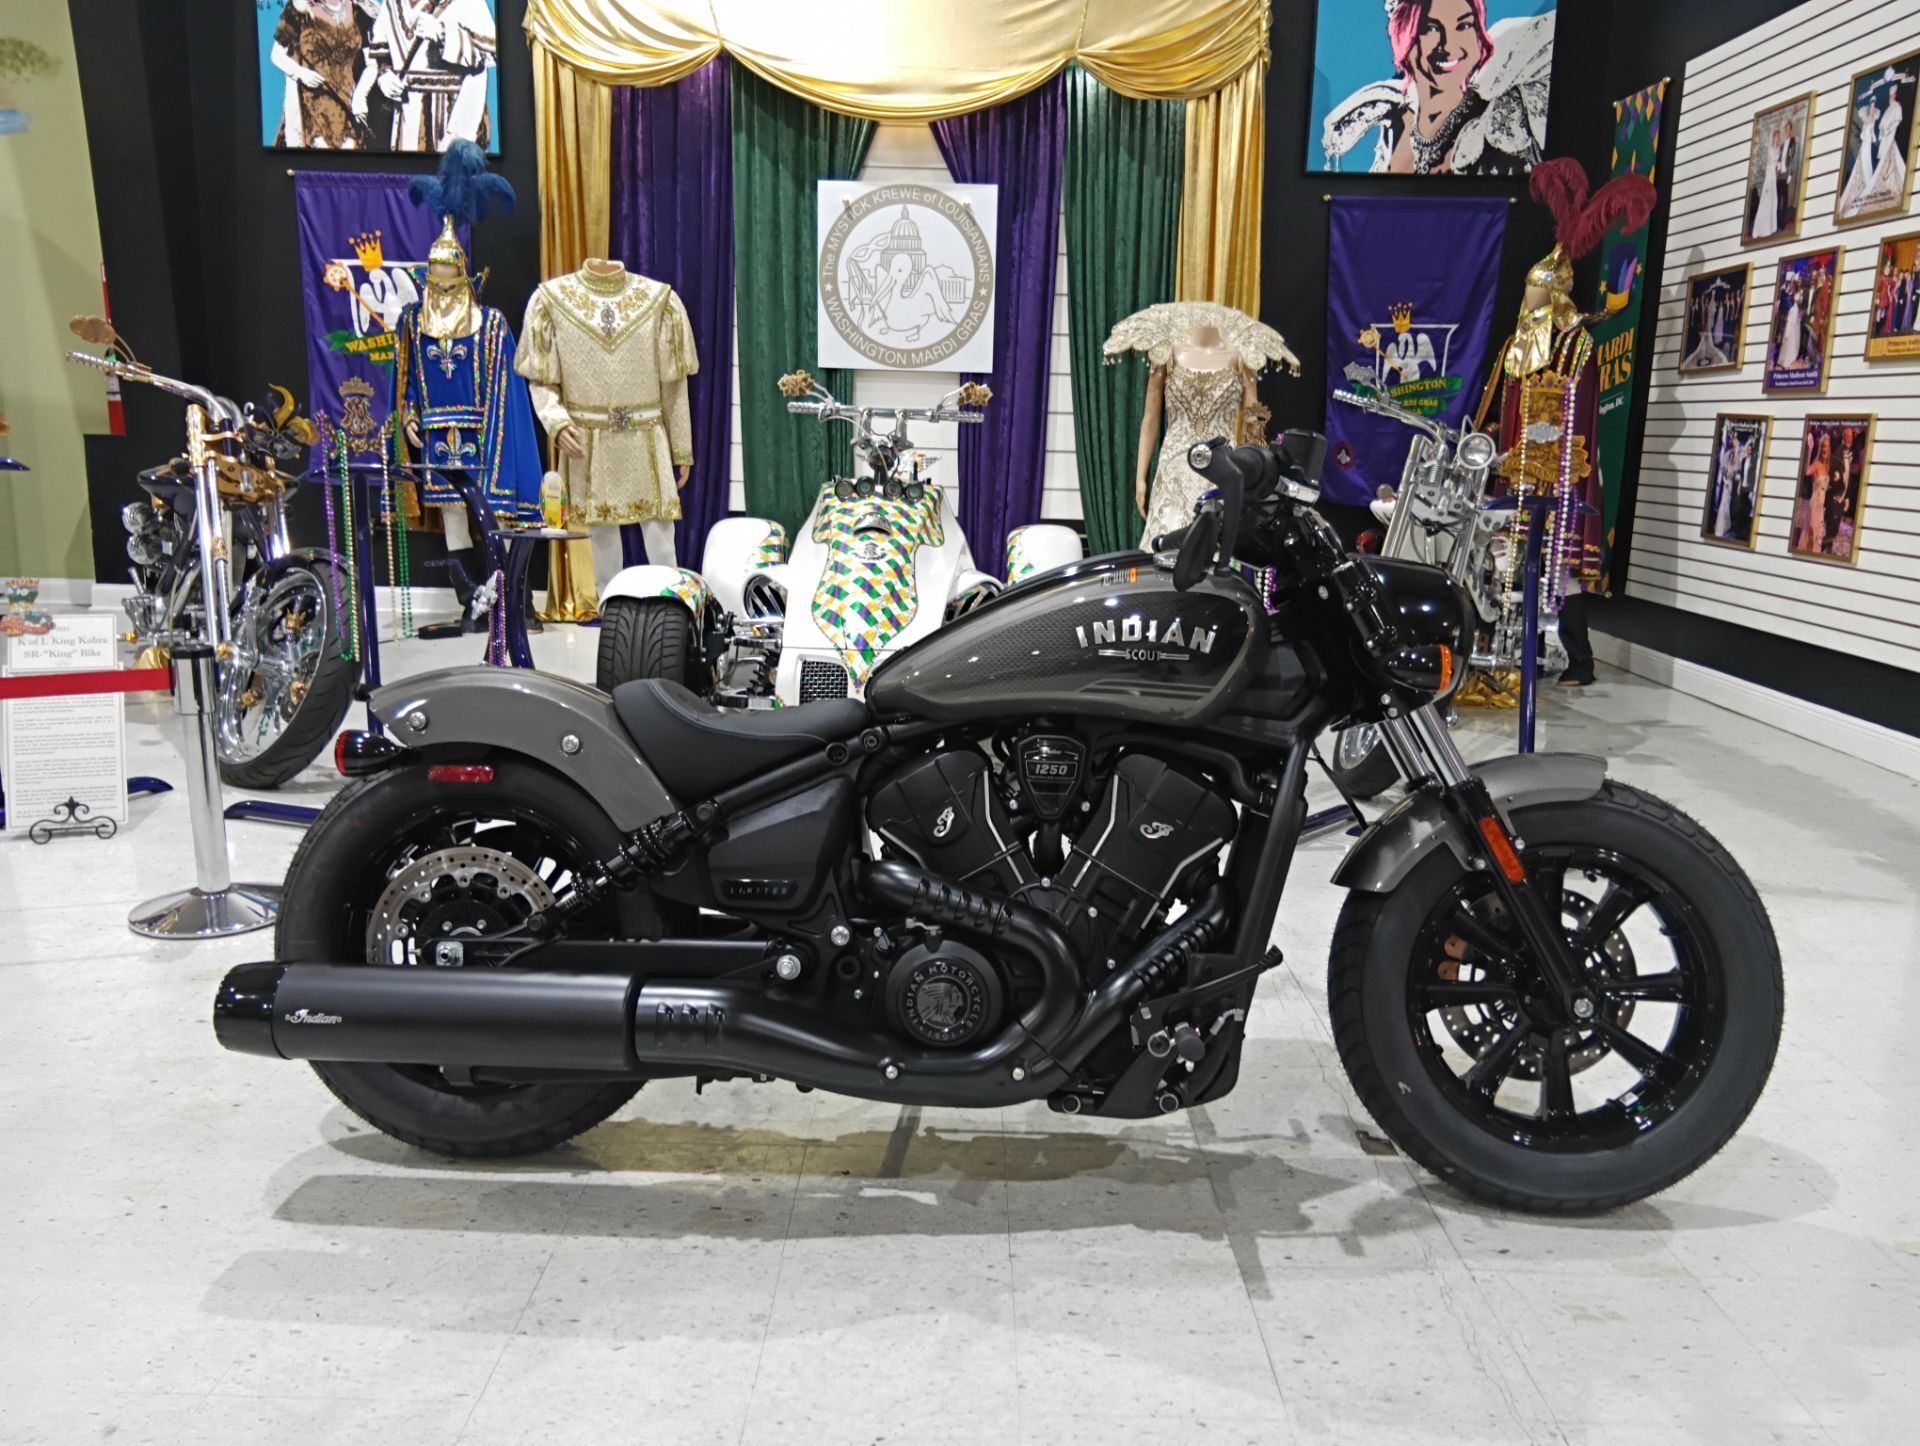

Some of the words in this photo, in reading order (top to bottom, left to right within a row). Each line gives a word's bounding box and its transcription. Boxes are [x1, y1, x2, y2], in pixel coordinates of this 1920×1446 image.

[872, 188, 921, 204] KREWE
[923, 193, 936, 203] of
[828, 200, 872, 251] MYSTICK
[938, 196, 990, 283] LOUISIANIANS
[823, 254, 837, 276] The
[826, 296, 907, 365] WASHINGTON
[911, 340, 959, 365] MARDI
[956, 301, 986, 341] GRAS
[1599, 352, 1632, 392] RAS
[52, 635, 76, 646] King
[79, 634, 108, 645] Kobra
[1075, 614, 1217, 653] INDIAN
[81, 648, 102, 657] Bike
[1125, 649, 1161, 661] SCOUT
[1035, 764, 1068, 775] 1250
[906, 971, 925, 1024] INDIAN
[929, 965, 981, 1029] MOTORCYCLE
[290, 1009, 337, 1024] Indian
